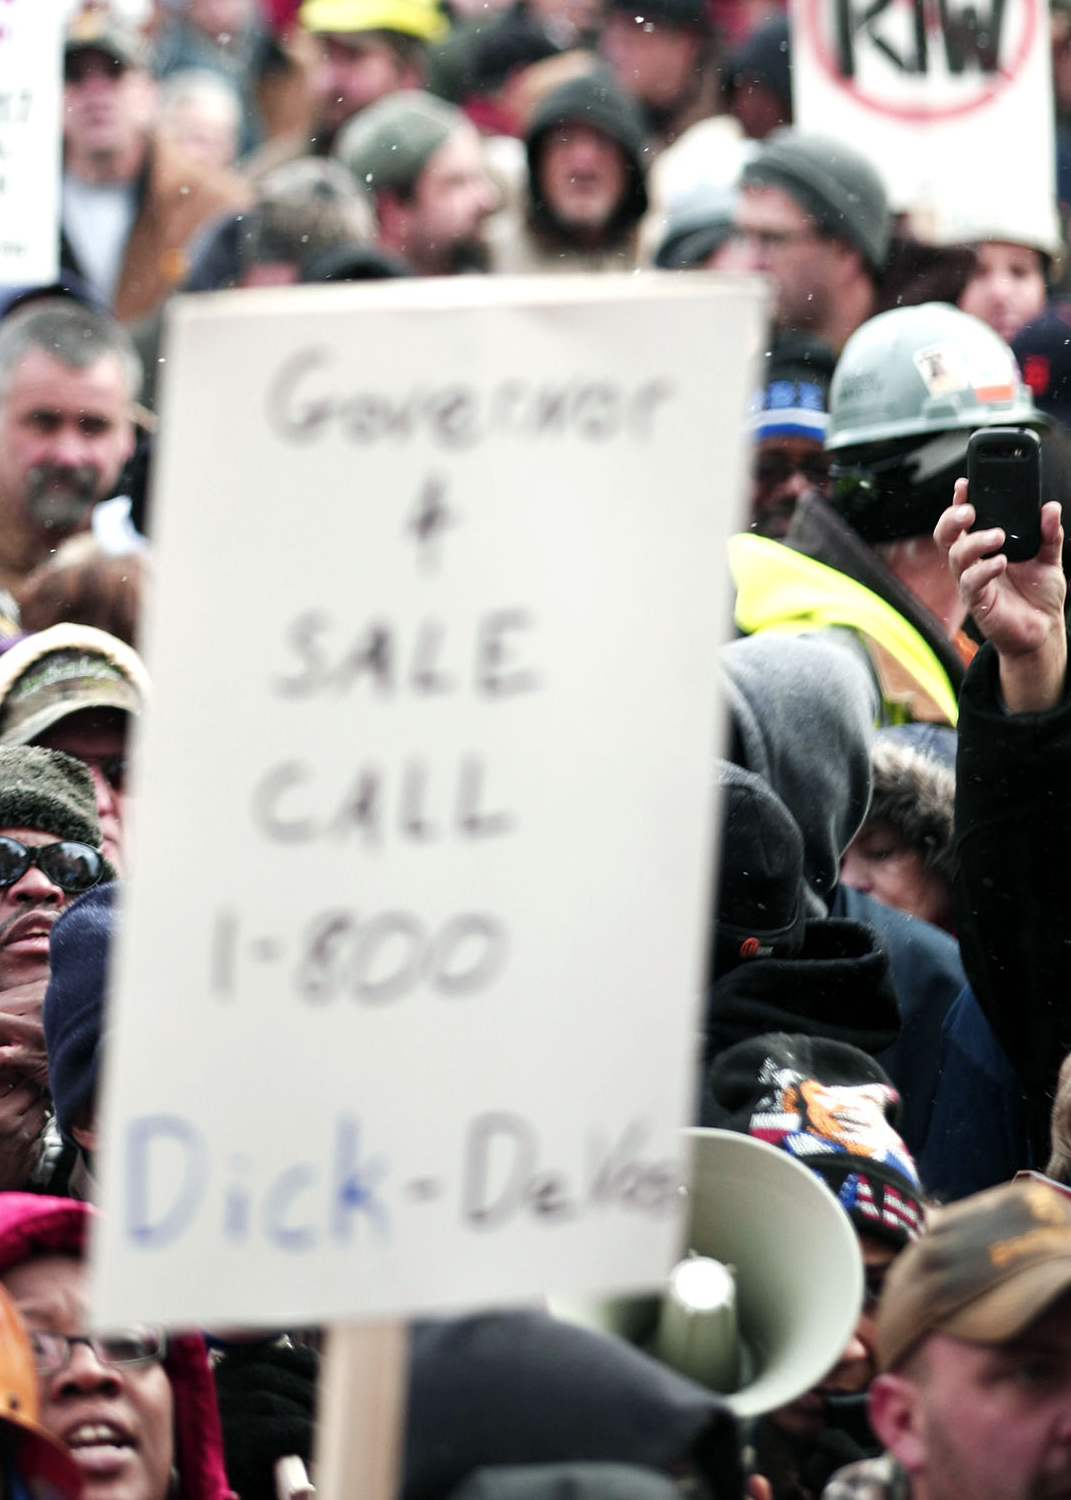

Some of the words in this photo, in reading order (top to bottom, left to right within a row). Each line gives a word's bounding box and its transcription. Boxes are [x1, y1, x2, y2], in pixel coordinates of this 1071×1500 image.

[272, 609, 545, 699] SALE
[256, 751, 516, 846] CALL
[212, 905, 508, 1007] 1-800
